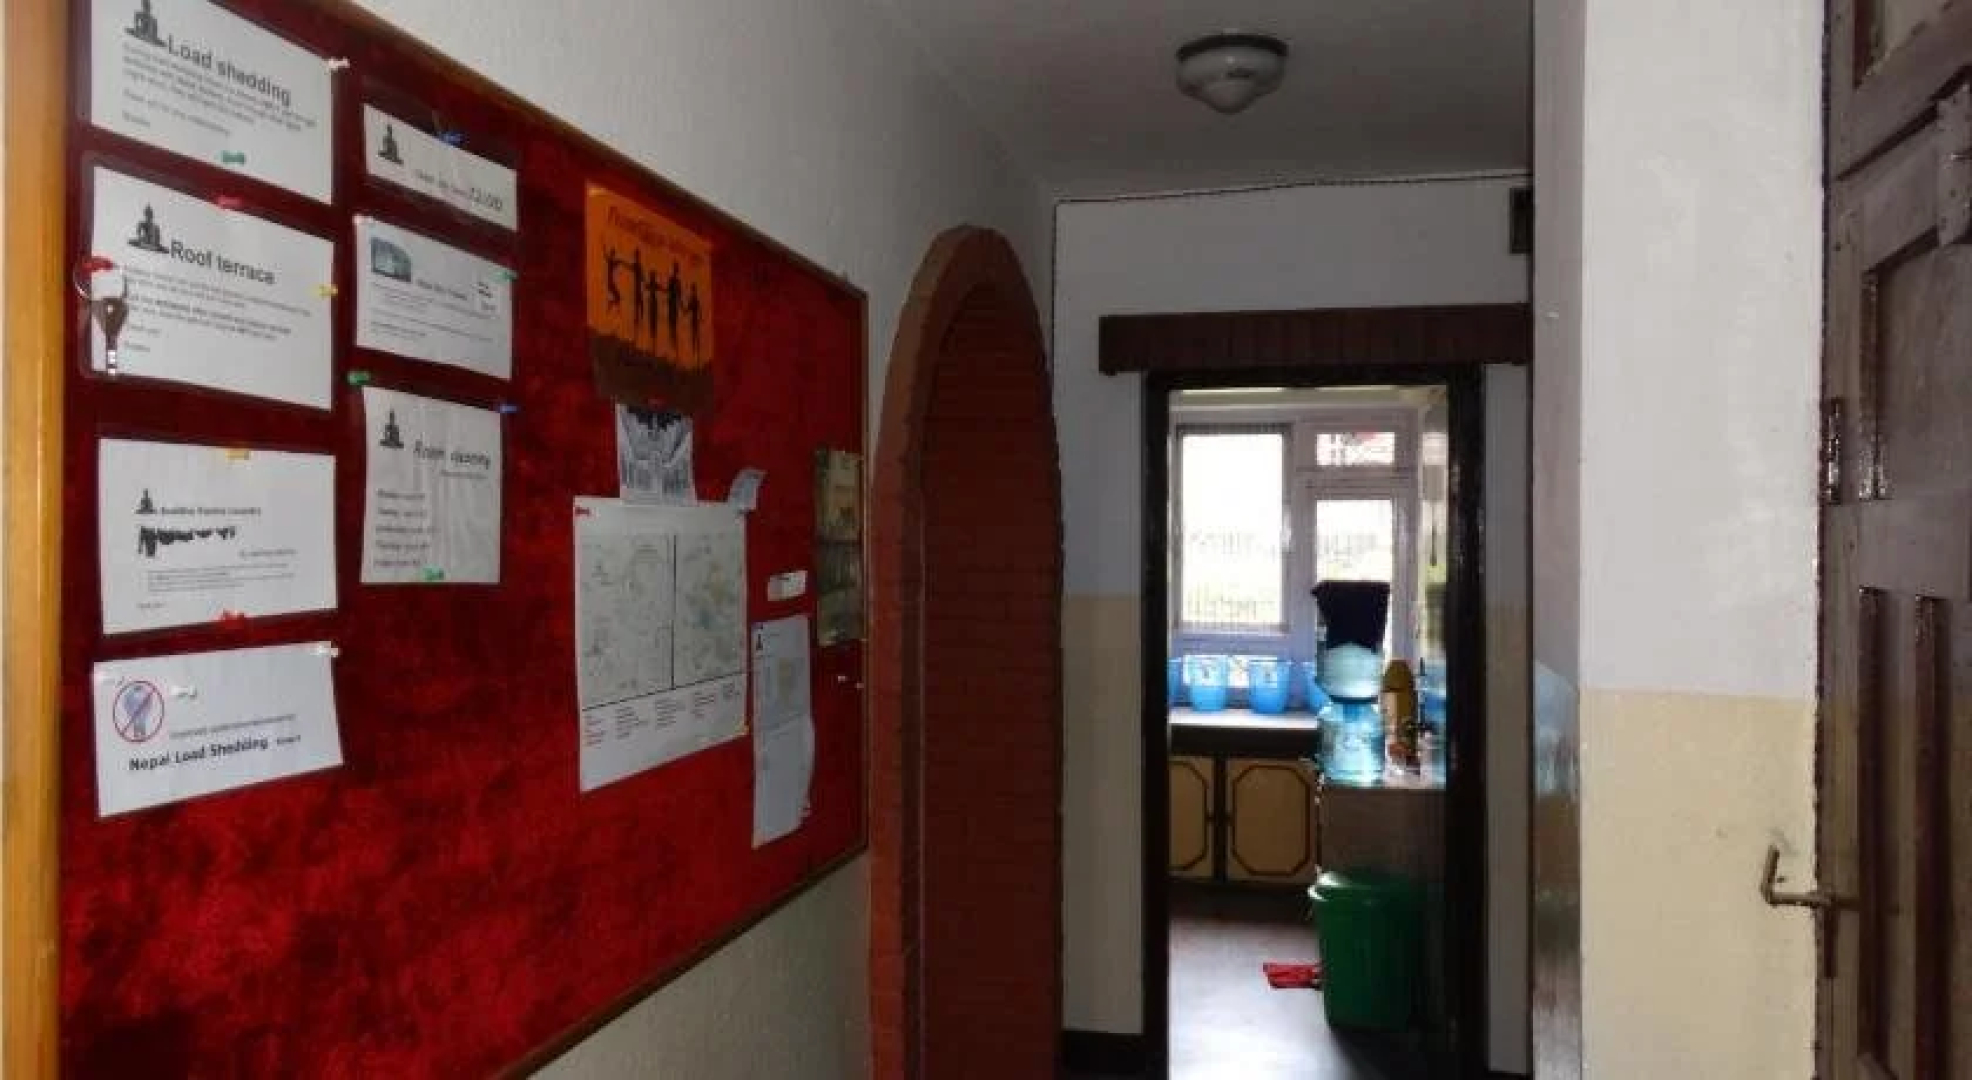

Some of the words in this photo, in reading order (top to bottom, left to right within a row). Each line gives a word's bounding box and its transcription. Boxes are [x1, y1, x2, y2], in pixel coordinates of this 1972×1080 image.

[168, 34, 212, 69] Load
[217, 59, 291, 107] shedding
[170, 239, 213, 269] Roof
[216, 254, 277, 285] terrace
[128, 753, 170, 772] Nepal
[174, 745, 206, 764] Load
[210, 737, 269, 758] Shedding
